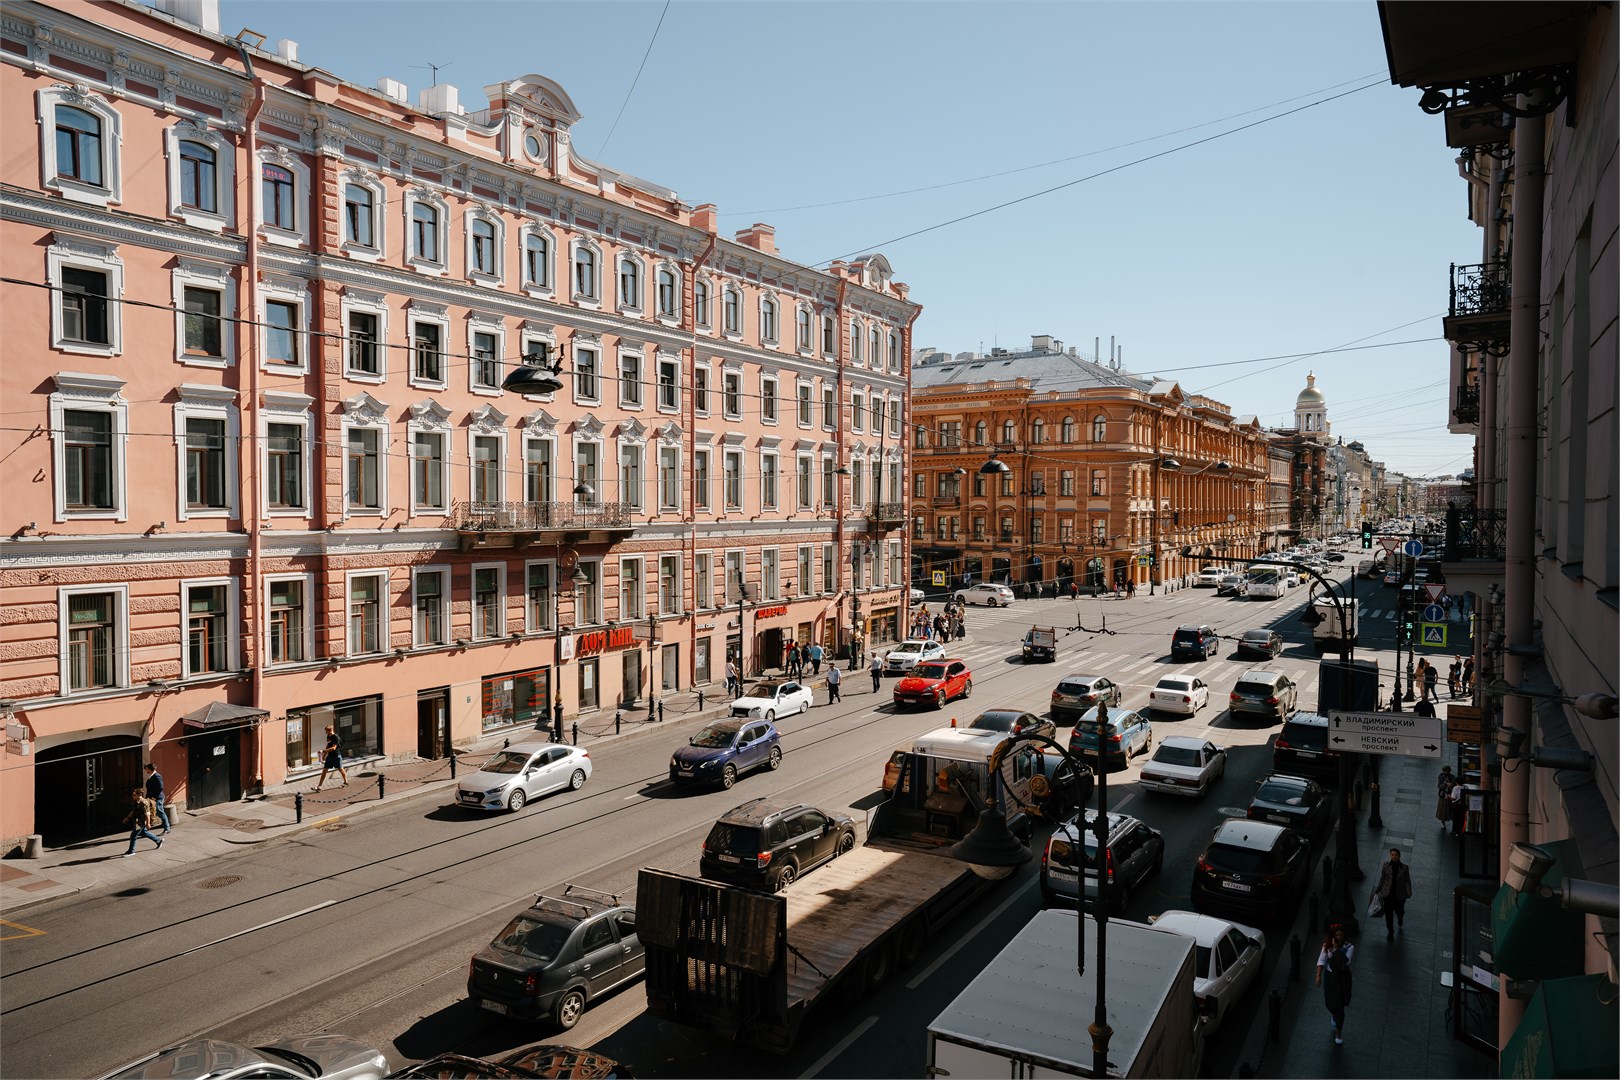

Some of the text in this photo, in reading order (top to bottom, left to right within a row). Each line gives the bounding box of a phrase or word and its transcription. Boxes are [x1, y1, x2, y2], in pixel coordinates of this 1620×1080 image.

[757, 606, 788, 619] ШАВЕРМА
[580, 627, 642, 654] ДОМ КНИ
[1346, 716, 1415, 727] ВЛАДИМИРСКИЙ
[1361, 725, 1398, 733] проспект
[1360, 736, 1399, 745] НЕВСКИЙ
